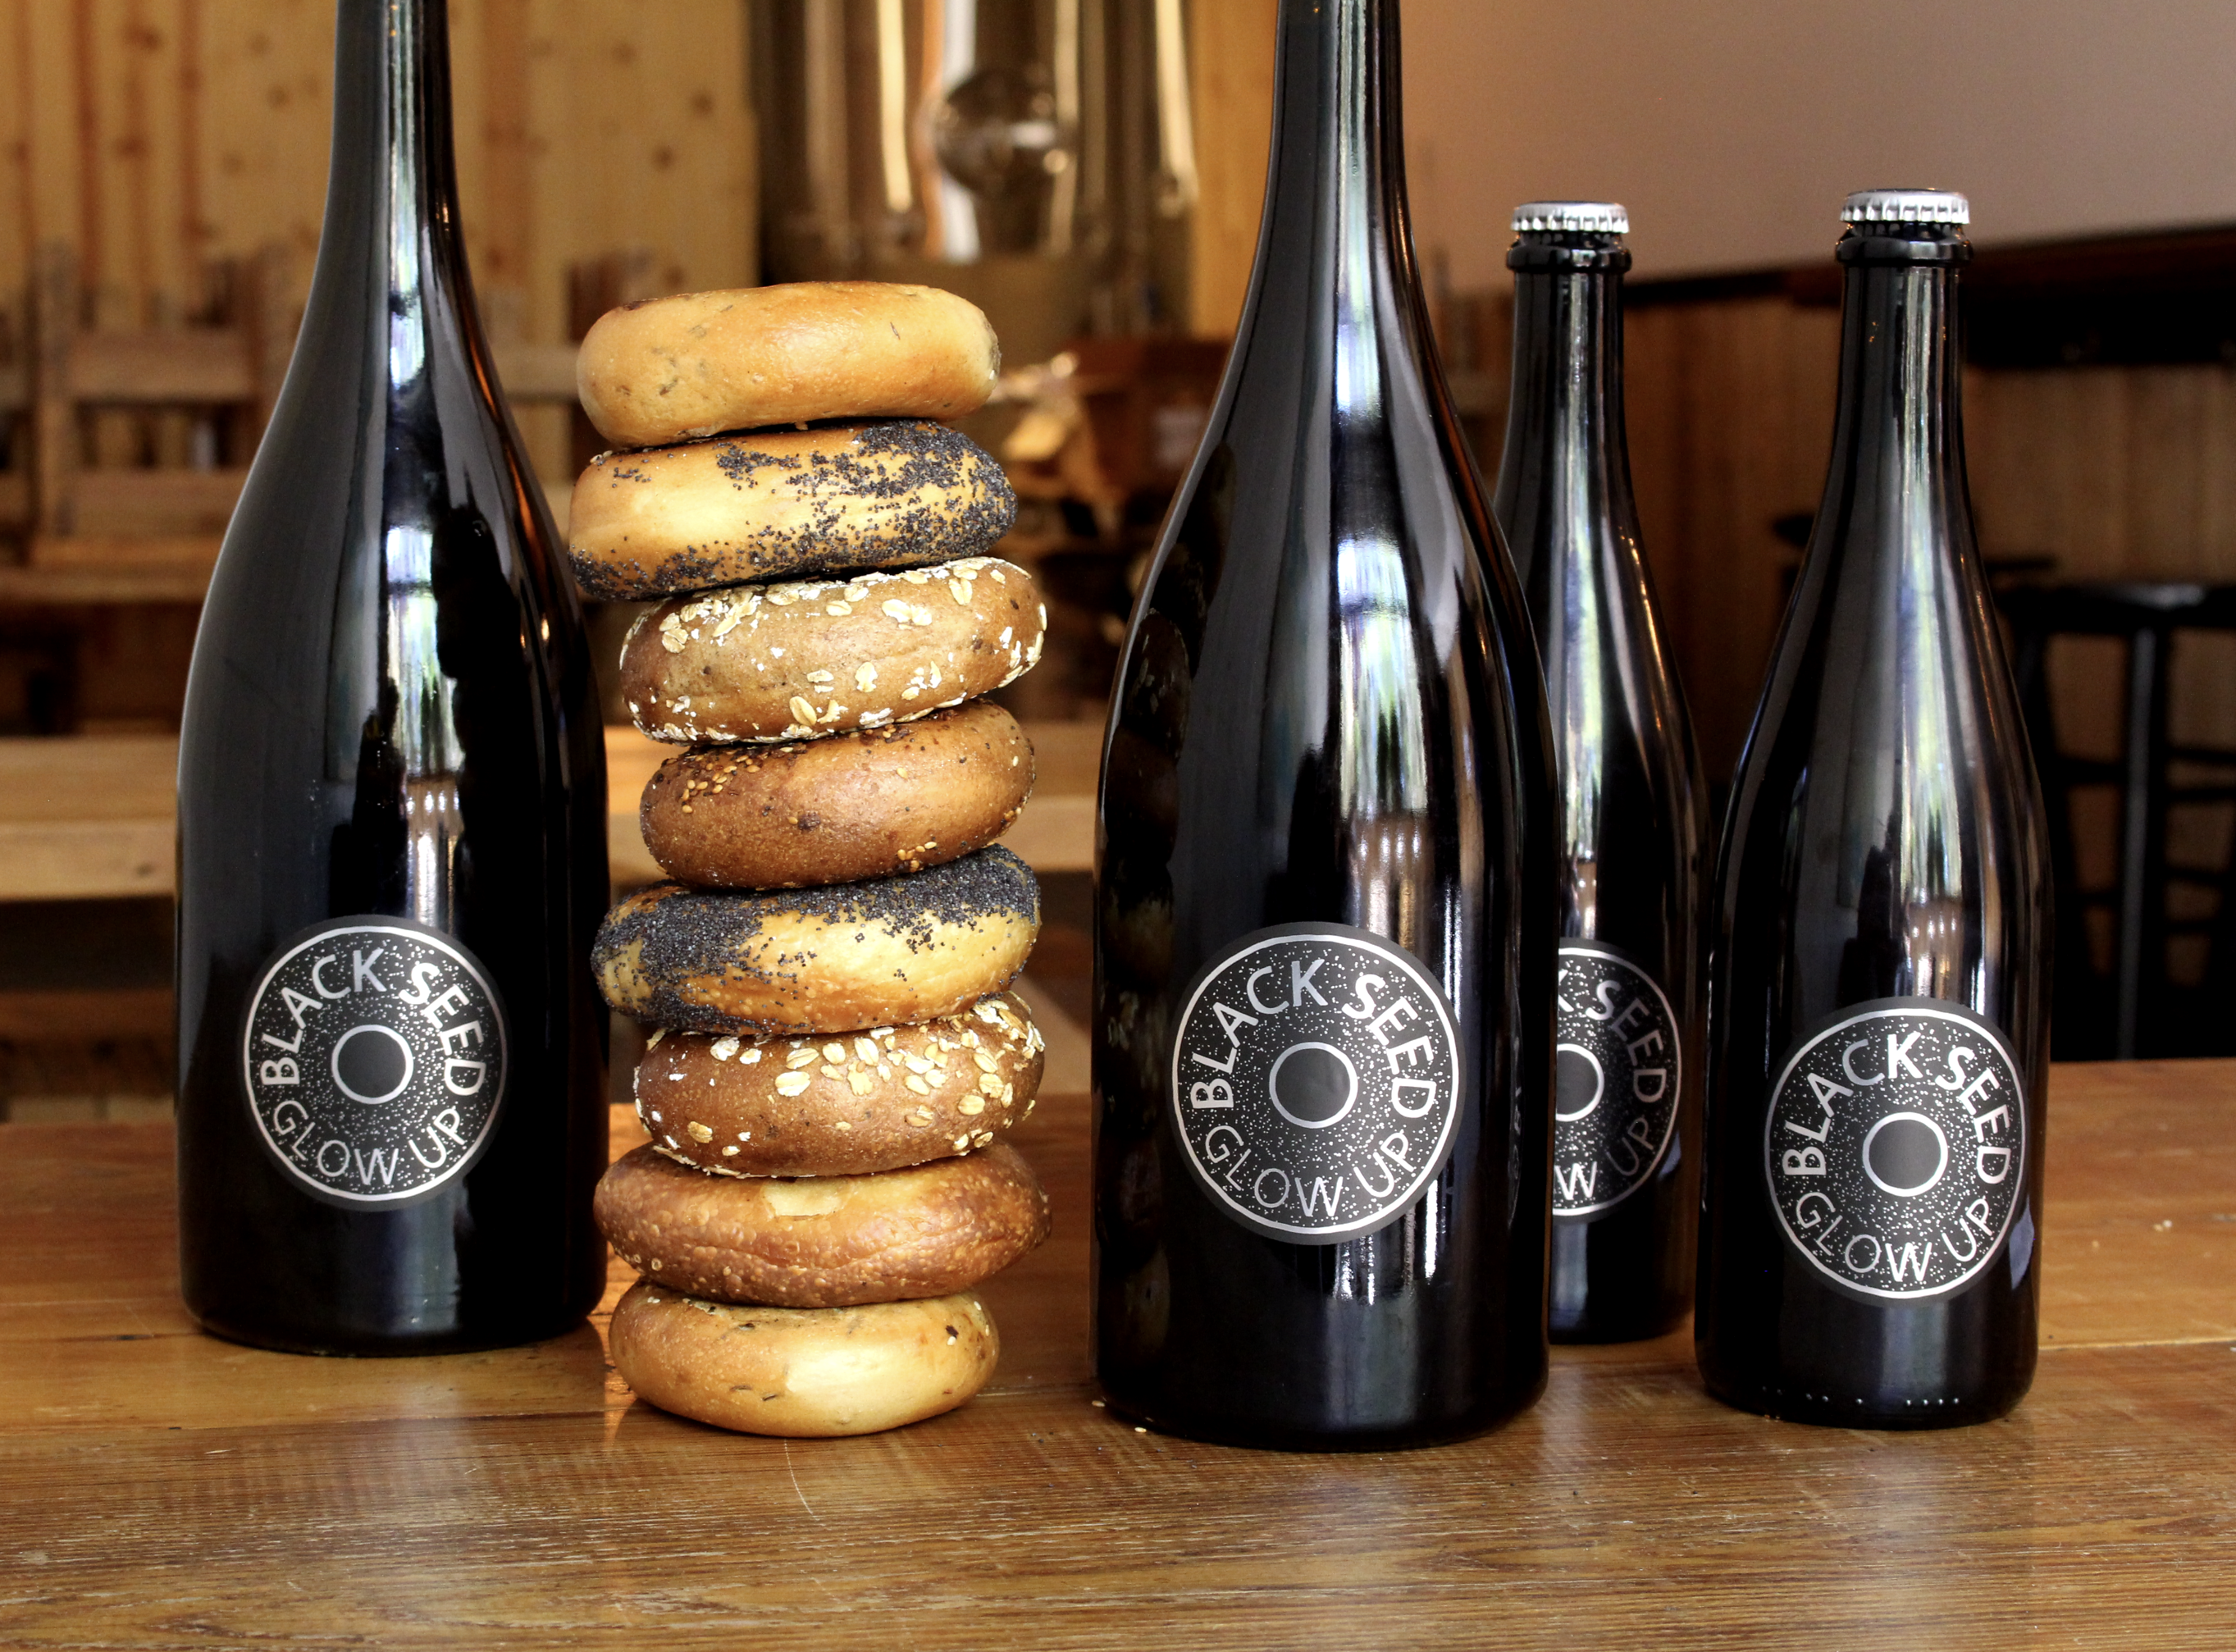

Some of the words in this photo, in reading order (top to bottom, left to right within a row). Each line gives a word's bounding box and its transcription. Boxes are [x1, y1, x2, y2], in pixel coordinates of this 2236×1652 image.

[260, 947, 387, 1085] BLACK
[398, 962, 486, 1096] SEED
[1190, 959, 1328, 1110] BLACK
[1342, 974, 1436, 1118] SEED
[1585, 979, 1667, 1103] SEED
[273, 1100, 399, 1185] GLOW
[409, 1108, 466, 1169] UP
[1606, 1116, 1654, 1176] UP
[1782, 1032, 1923, 1176] BLACK
[1935, 1047, 2010, 1184] SEED
[1205, 1125, 1344, 1216] GLOW
[1353, 1132, 1415, 1198] UP
[1796, 1192, 1933, 1282] GLOW
[1942, 1198, 1993, 1262] UP
